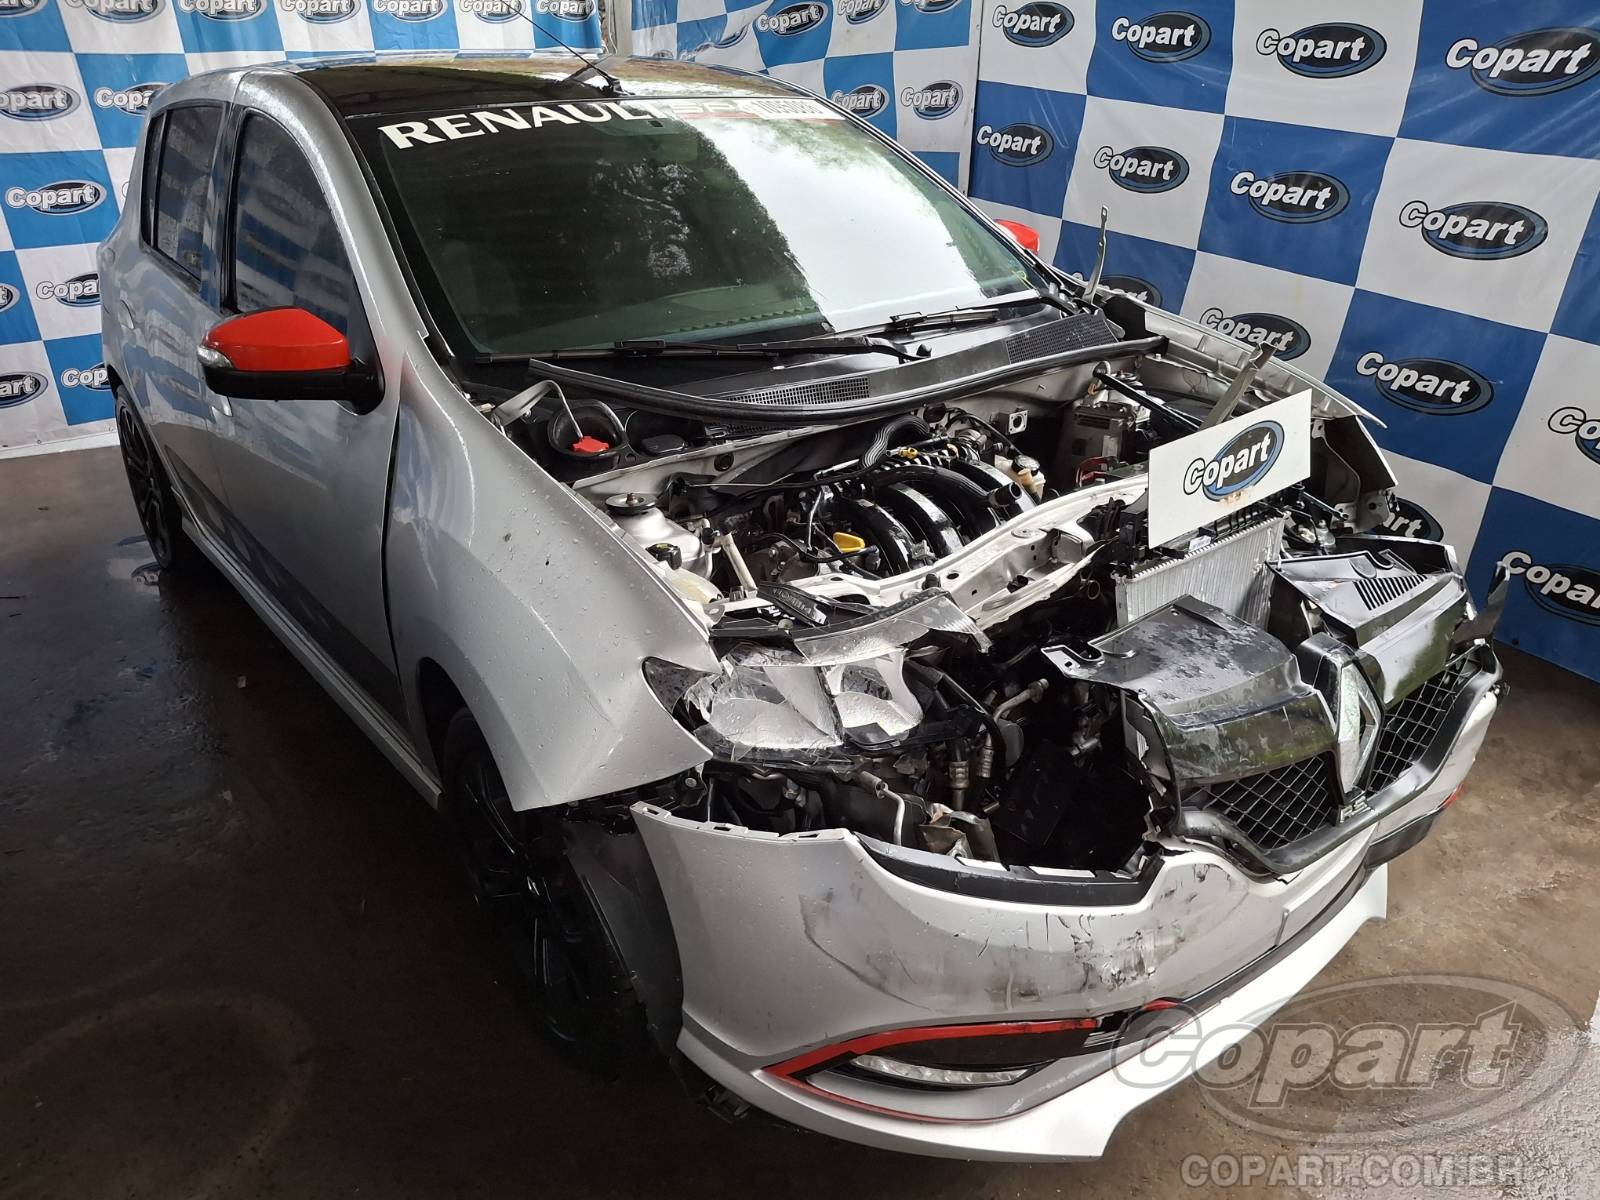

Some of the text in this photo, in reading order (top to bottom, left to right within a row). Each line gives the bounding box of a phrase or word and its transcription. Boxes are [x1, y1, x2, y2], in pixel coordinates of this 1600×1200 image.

[757, 3, 820, 32] Copart
[994, 6, 1061, 34] Copart
[1112, 18, 1196, 48] Copart
[1258, 29, 1366, 62] Copart
[1447, 39, 1593, 78] Copart
[902, 84, 956, 112] Copart
[977, 126, 1041, 155] Copart
[1095, 148, 1175, 181] Copart
[7, 185, 95, 208] Copart
[1231, 171, 1332, 210] Copart
[1401, 201, 1526, 245] Copart
[37, 281, 99, 300] Copa
[1200, 308, 1295, 351] Copart
[1356, 352, 1471, 403] Copart
[1183, 432, 1271, 495] Copart
